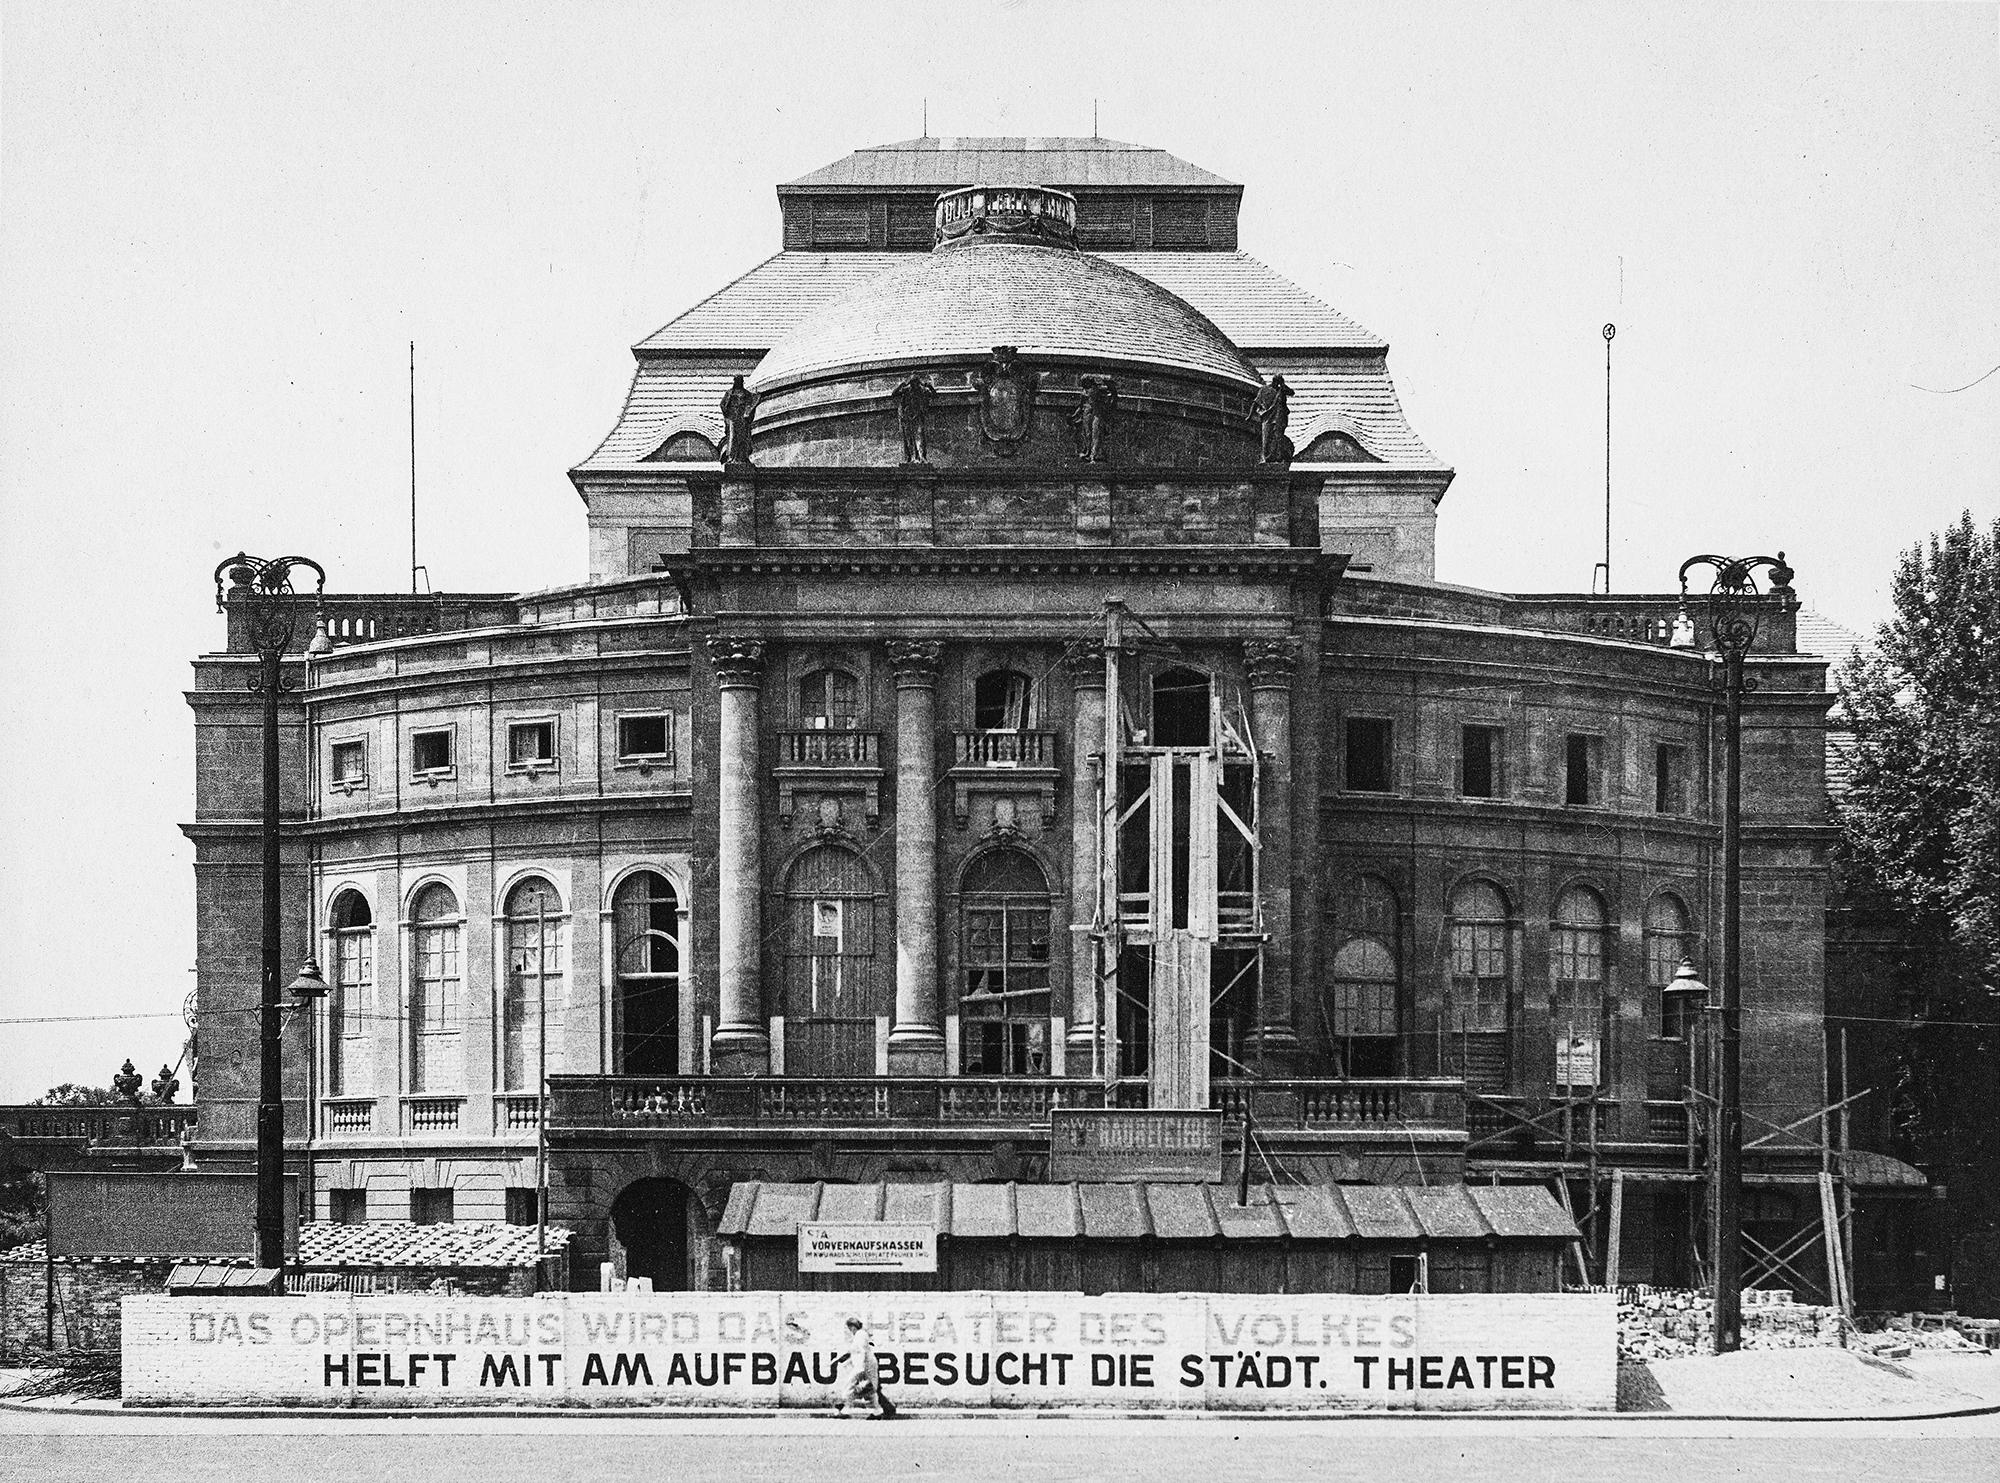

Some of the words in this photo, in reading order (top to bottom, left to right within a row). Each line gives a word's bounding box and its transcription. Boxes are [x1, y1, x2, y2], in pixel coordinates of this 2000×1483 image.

[811, 1240, 923, 1251] VORVERKAUFSKASSEN
[190, 1311, 274, 1347] DAS
[290, 1311, 562, 1346] OPERNHAUS
[582, 1311, 700, 1344] WIRD
[718, 1311, 811, 1345] DAS
[1080, 1312, 1167, 1345] DES
[1213, 1313, 1415, 1349] VOLKES
[324, 1354, 457, 1388] HELFT
[479, 1354, 562, 1387] MIT
[582, 1353, 654, 1386] AM
[667, 1352, 839, 1386] AUFBAU
[876, 1352, 1074, 1386] BESUCHT
[1091, 1353, 1155, 1387] DIE
[1179, 1350, 1327, 1389] STÄDT.
[1353, 1355, 1556, 1390] THEATER
